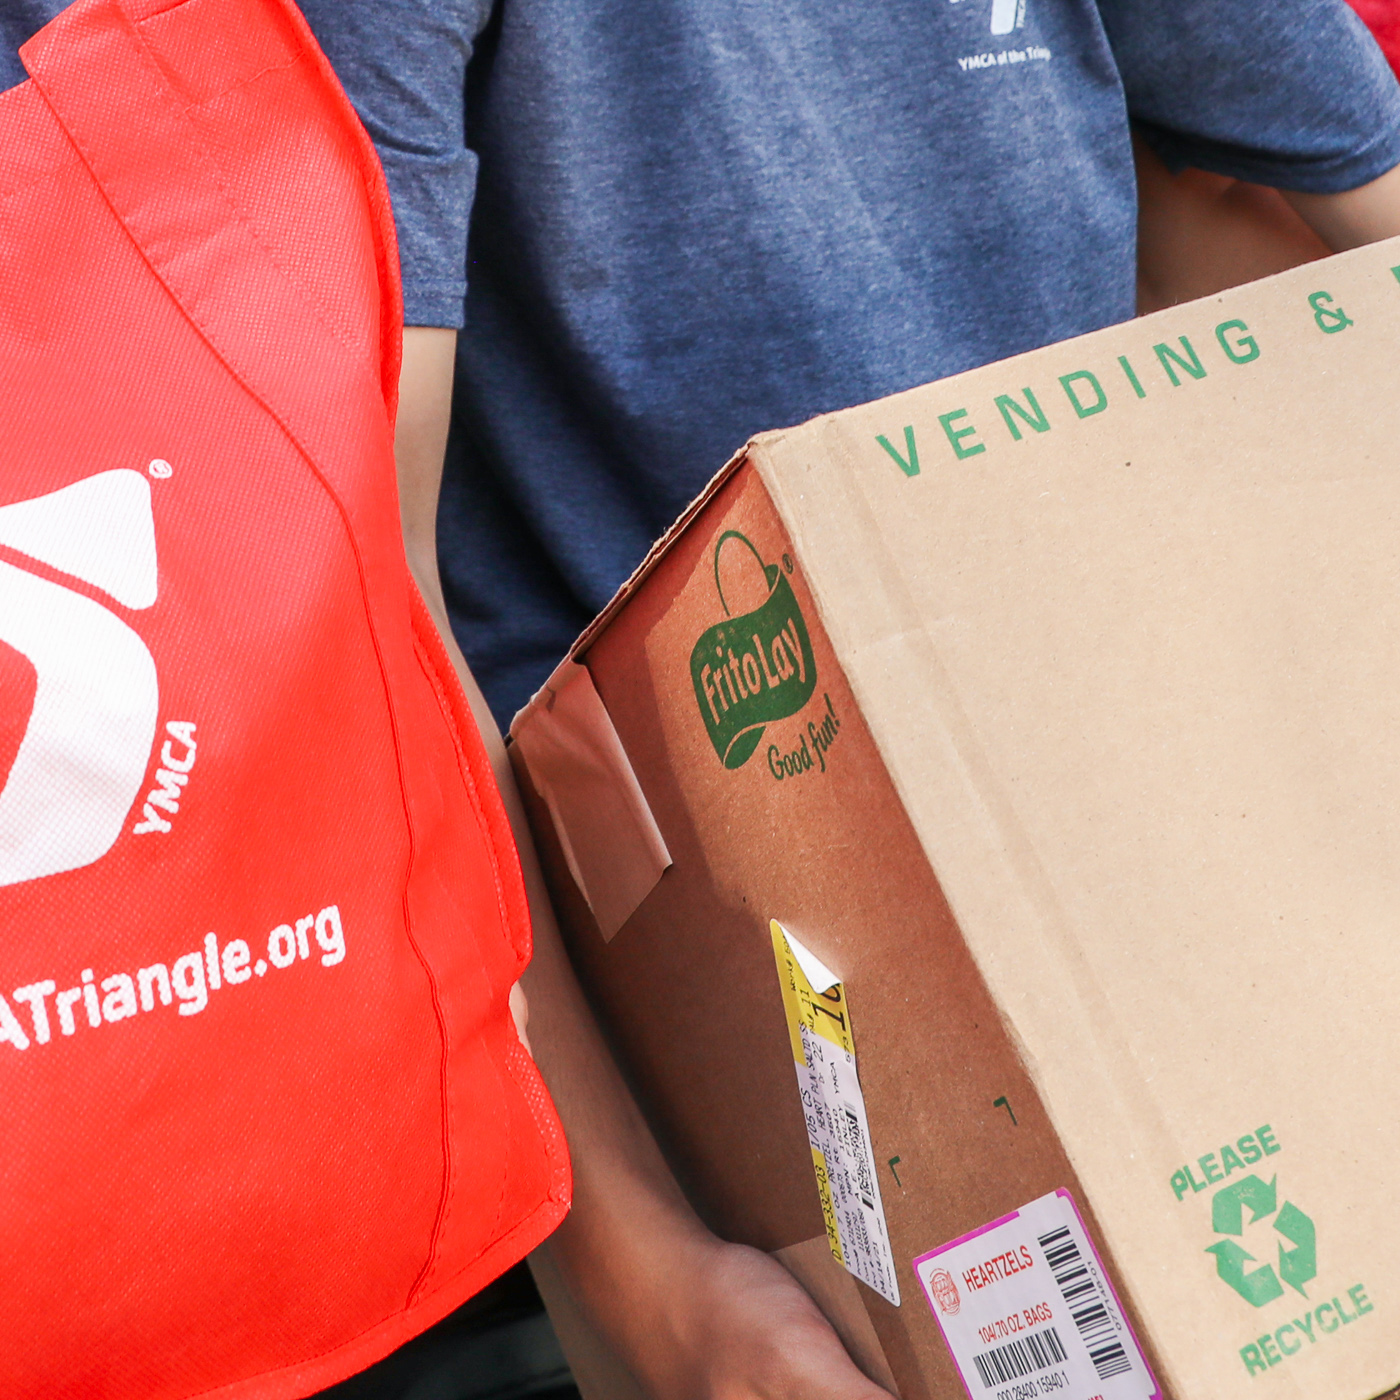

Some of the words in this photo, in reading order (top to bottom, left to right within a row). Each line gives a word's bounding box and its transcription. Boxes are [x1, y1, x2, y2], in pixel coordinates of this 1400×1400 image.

[958, 52, 997, 71] YMCA
[876, 319, 1260, 478] VENDING
[1308, 291, 1354, 334] &
[768, 733, 814, 781] Good
[808, 693, 841, 773] fun!
[133, 719, 196, 835] YMCA
[799, 988, 811, 1007] 11
[810, 1038, 823, 1062] 22
[800, 1085, 812, 1108] CS
[828, 1058, 840, 1096] YMCA
[812, 1095, 826, 1131] HEART
[837, 1103, 851, 1157] FINLEY
[1170, 1124, 1281, 1202] PLEASE
[962, 1245, 1033, 1292] HEARTZELS
[1007, 1314, 1026, 1333] OZ.
[1023, 1302, 1053, 1327] BAGS
[1238, 1283, 1374, 1377] RECYCLE
